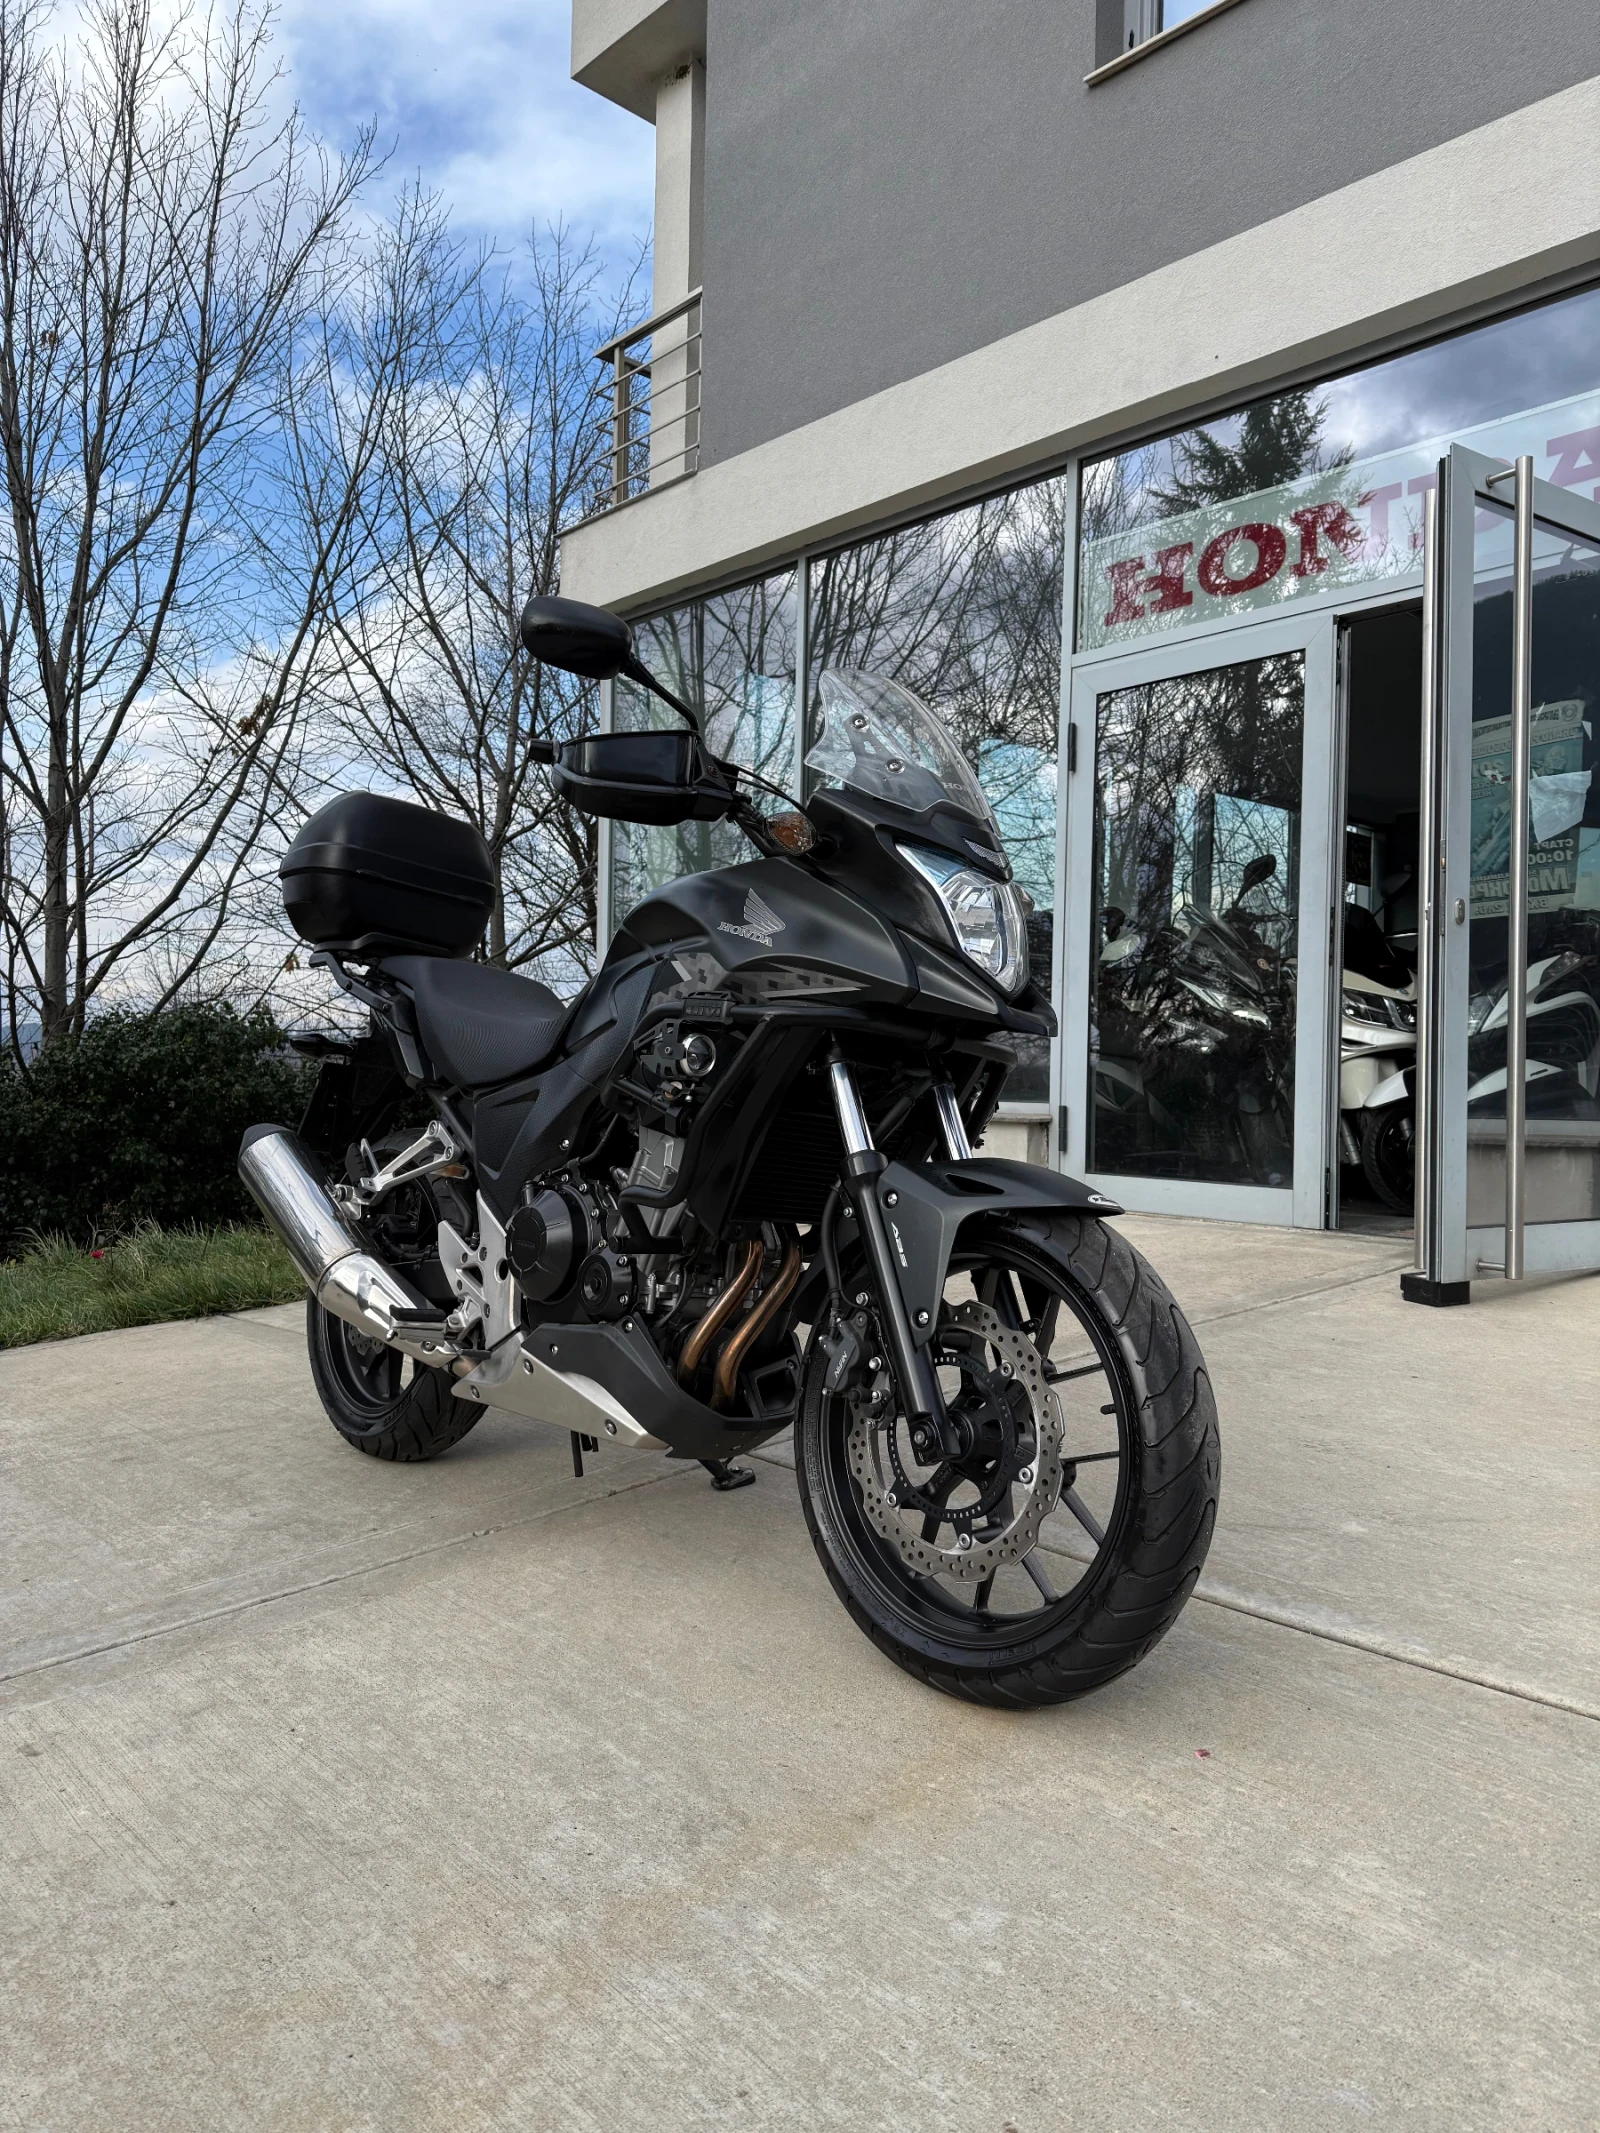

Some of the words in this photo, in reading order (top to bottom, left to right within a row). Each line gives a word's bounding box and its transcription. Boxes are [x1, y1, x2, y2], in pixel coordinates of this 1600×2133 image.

[717, 921, 773, 948] HONDA
[686, 1004, 722, 1018] GIVI
[891, 1221, 908, 1268] ABS
